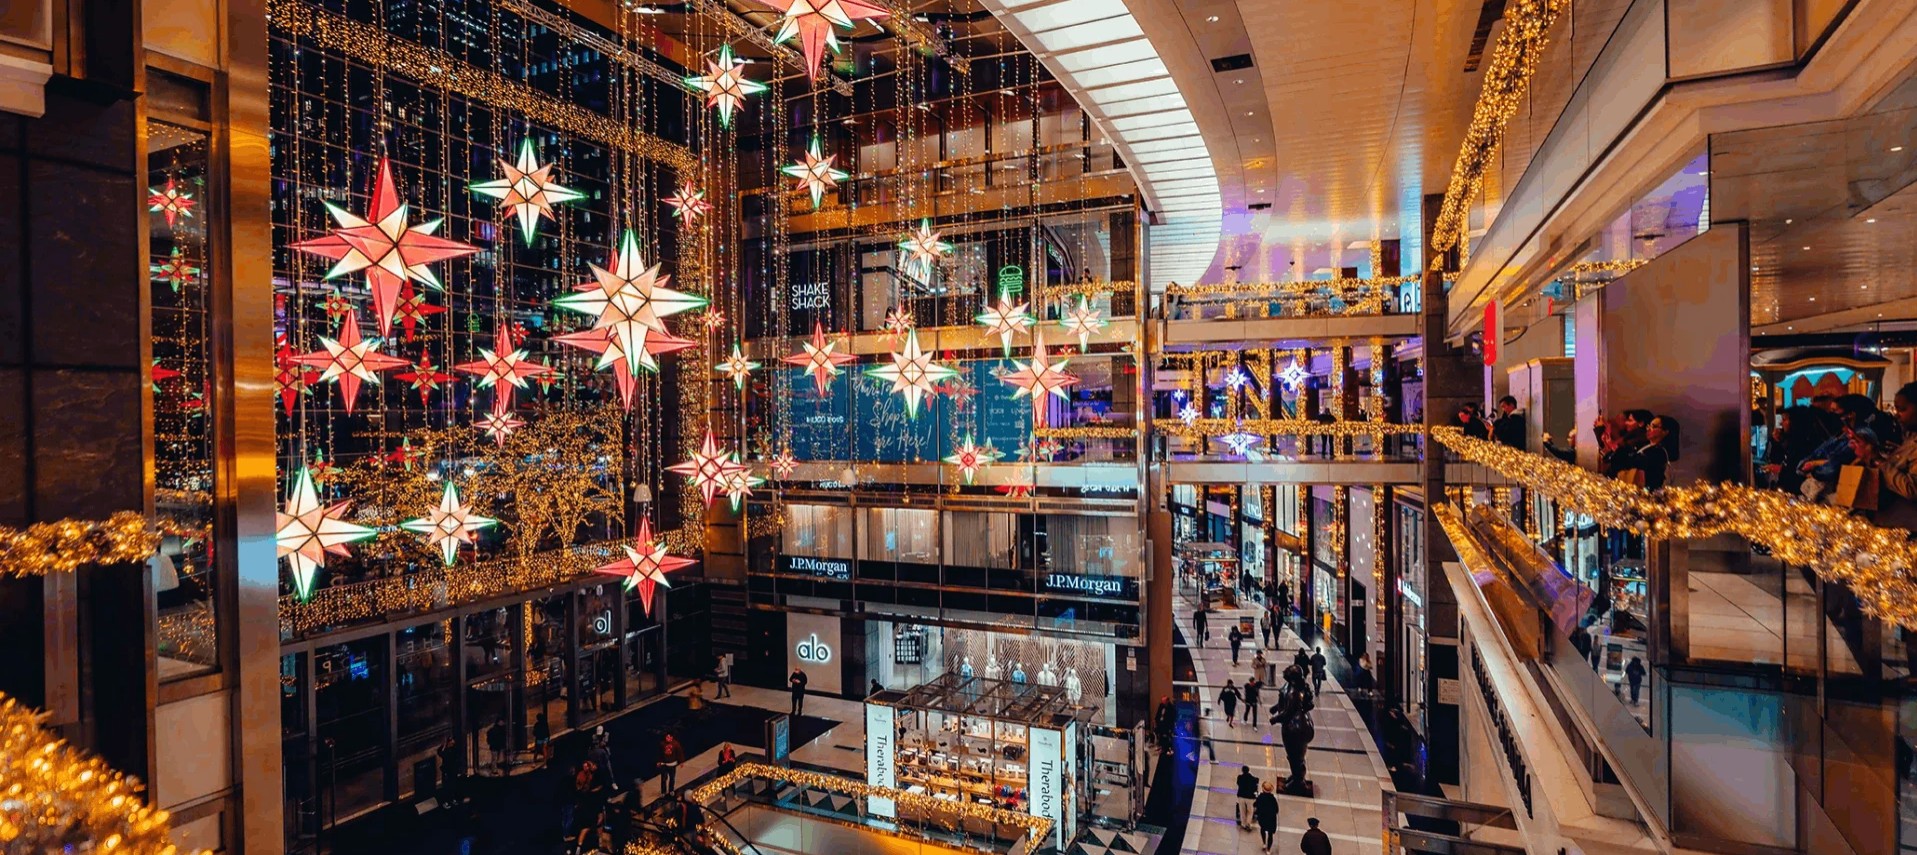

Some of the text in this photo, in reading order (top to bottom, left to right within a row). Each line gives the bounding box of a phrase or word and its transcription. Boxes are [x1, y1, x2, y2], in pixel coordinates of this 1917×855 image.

[792, 282, 830, 298] SHAKE
[792, 295, 831, 310] SHACK
[869, 397, 907, 432] Shops
[789, 557, 848, 576] J.P.Morgan
[1046, 574, 1122, 595] J.P.Morgan
[797, 633, 830, 662] alo
[877, 735, 888, 788] Therabod
[1041, 760, 1054, 818] Therabod
